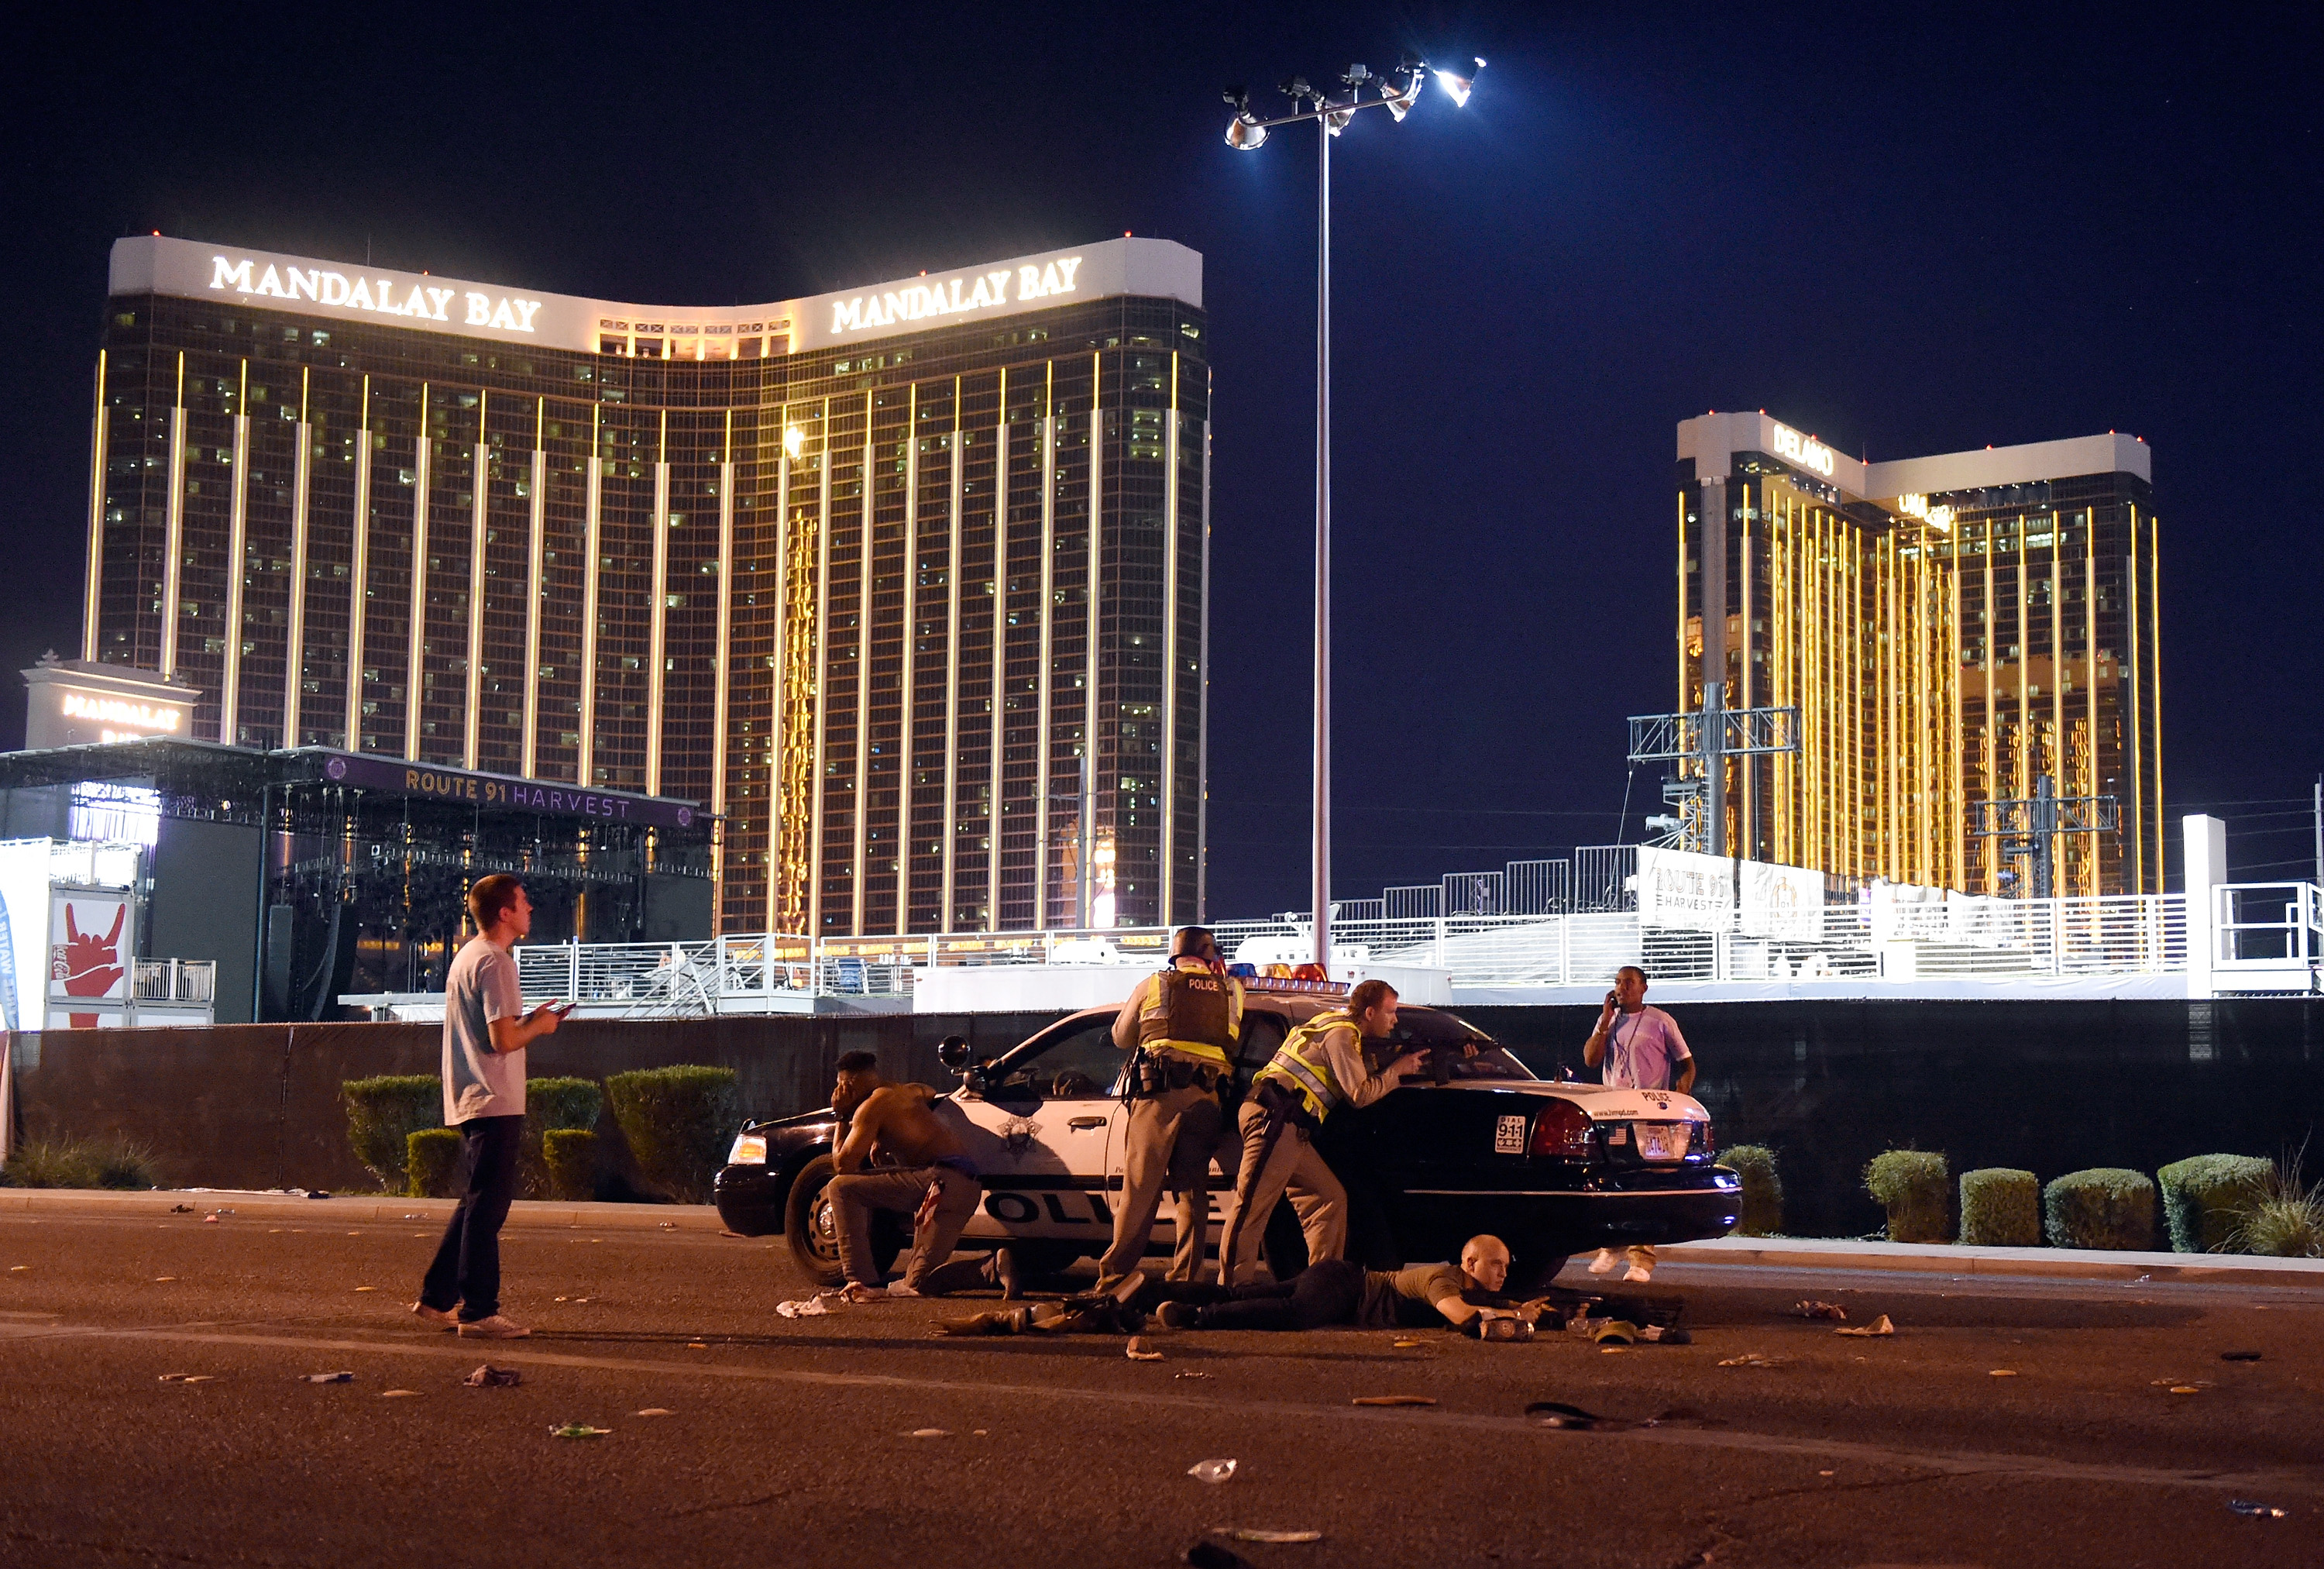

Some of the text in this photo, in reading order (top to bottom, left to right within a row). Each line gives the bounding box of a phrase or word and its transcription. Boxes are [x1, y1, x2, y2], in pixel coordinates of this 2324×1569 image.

[210, 256, 542, 332] MANDALAY BAY
[830, 256, 1082, 334] MANDALAY BAY
[1772, 424, 1834, 477] DELANO
[63, 694, 180, 731] MANDALAY
[405, 769, 630, 818] ROUTE 91 HARVEST
[1655, 867, 1704, 896] ROUTE
[1666, 896, 1713, 910] HARVEST
[1189, 979, 1219, 992] POLICE
[1641, 1092, 1672, 1102] POLICE
